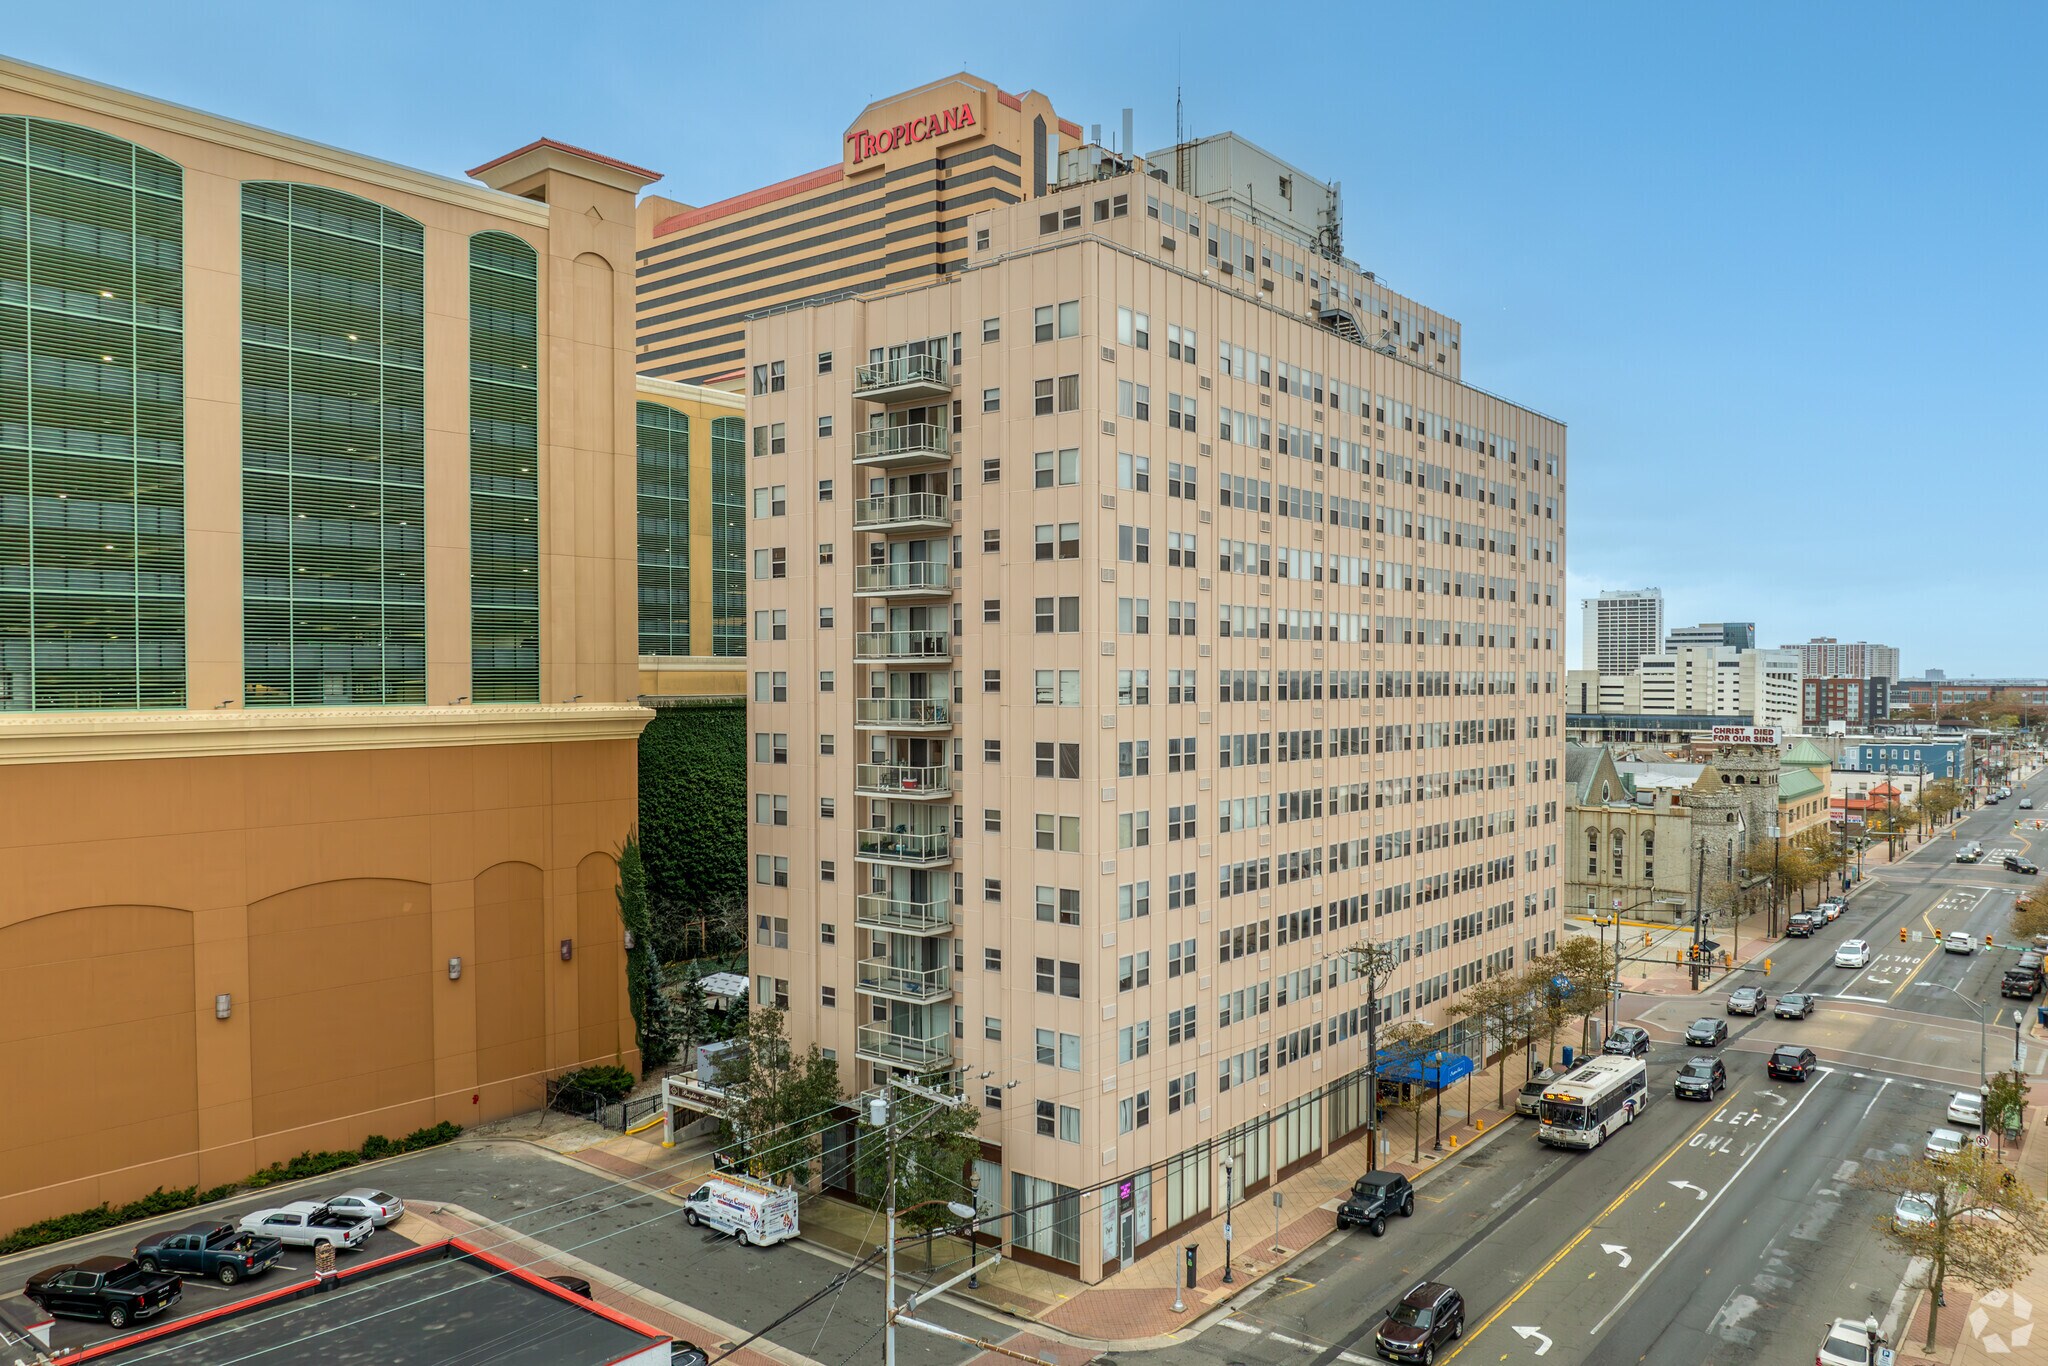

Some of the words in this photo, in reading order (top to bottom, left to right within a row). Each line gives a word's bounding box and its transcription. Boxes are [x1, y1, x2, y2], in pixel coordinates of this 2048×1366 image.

[847, 103, 976, 164] TROPICANA
[1753, 728, 1774, 736] DIED
[1881, 955, 1921, 964] ONLY
[1871, 965, 1912, 975] LEFT
[1713, 1108, 1778, 1130] LEFT
[1688, 1133, 1756, 1157] ONLY
